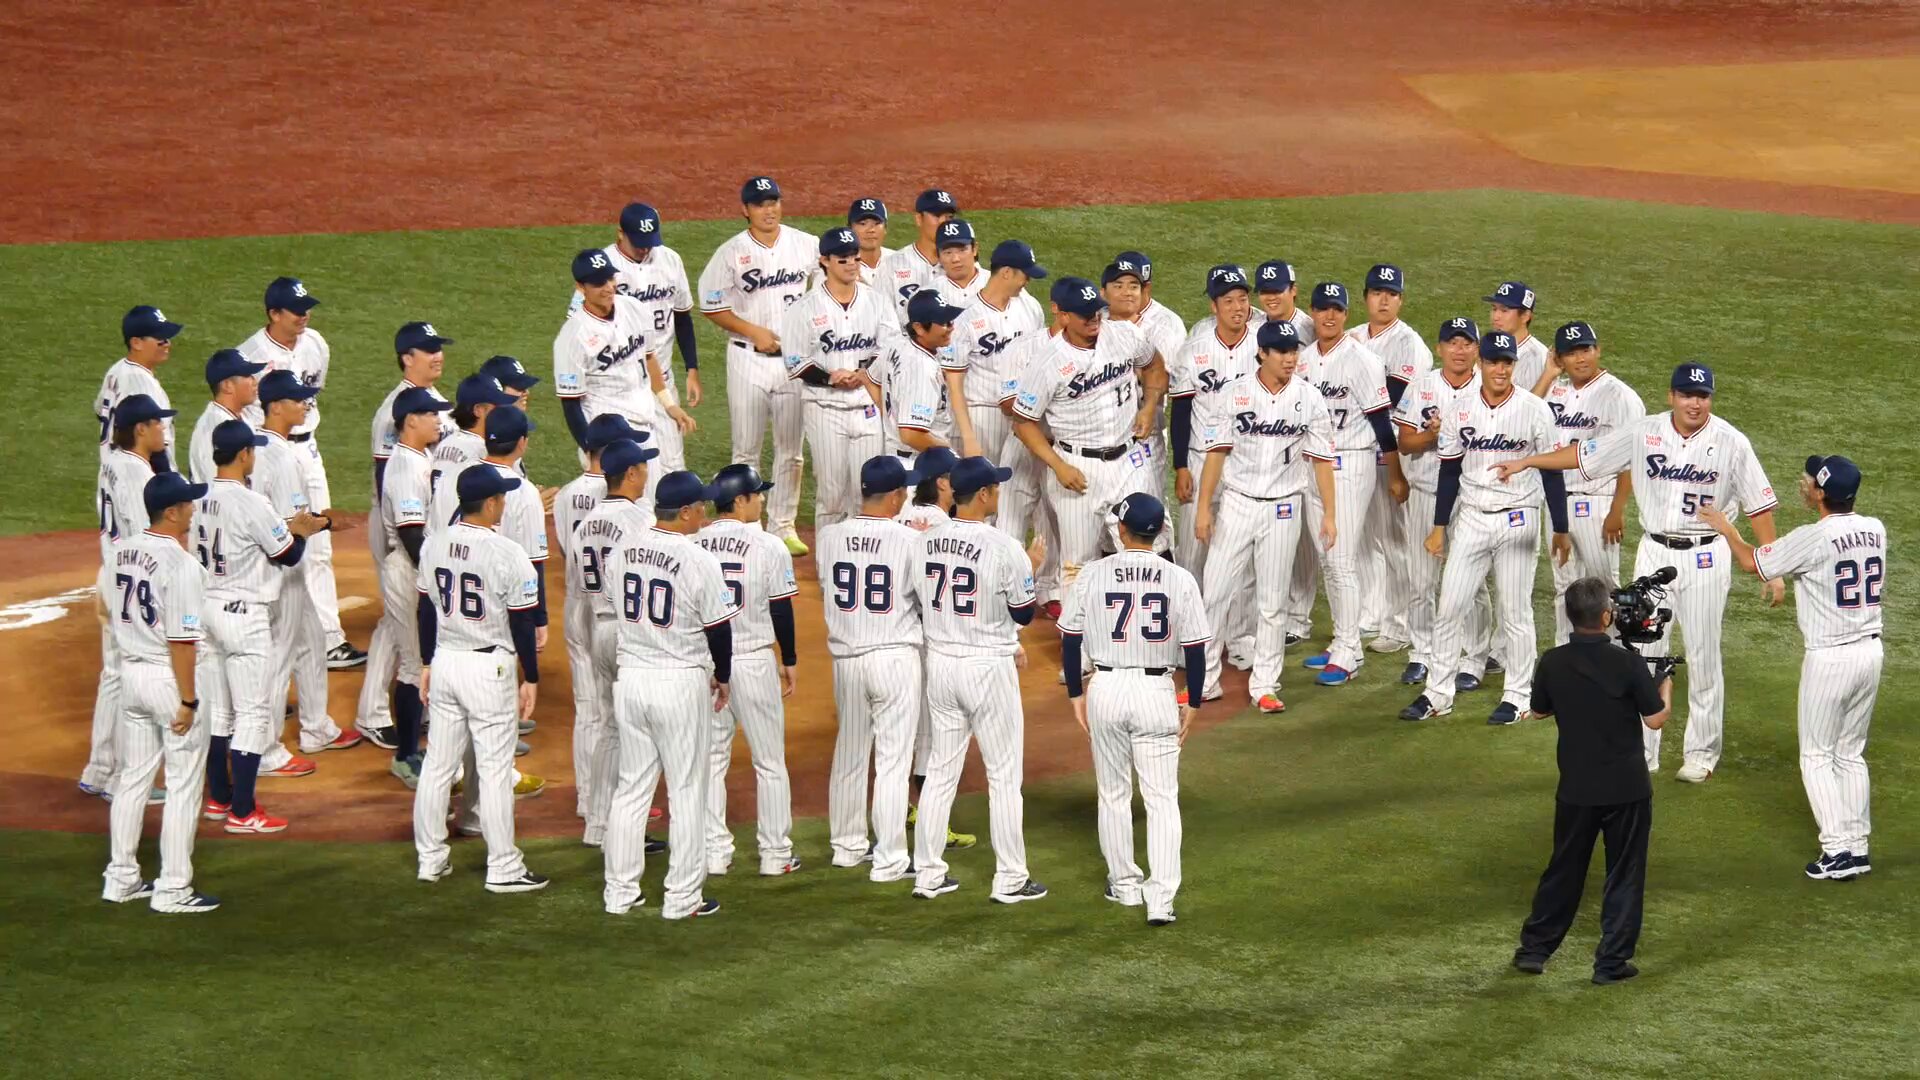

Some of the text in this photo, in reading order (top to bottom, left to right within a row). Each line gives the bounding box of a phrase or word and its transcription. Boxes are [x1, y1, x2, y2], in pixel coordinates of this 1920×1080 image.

[756, 178, 771, 191] YS
[860, 199, 876, 211] YS
[639, 218, 654, 232] YS
[944, 223, 959, 236] YS
[589, 255, 607, 269] YS
[741, 268, 806, 293] Swallows
[1262, 266, 1277, 280] YS
[1378, 267, 1395, 281] YS
[1080, 286, 1097, 301] YS
[1323, 284, 1341, 297] YS
[1279, 323, 1295, 337] YS
[1565, 326, 1582, 341] YS
[597, 332, 645, 371] Swallow
[1494, 335, 1510, 348] YS
[1067, 359, 1132, 399] Swallows
[1689, 368, 1705, 383] YS
[1236, 411, 1308, 437] Swallows
[1460, 427, 1527, 450] Swallows
[1646, 454, 1718, 483] Swallows
[572, 494, 596, 511] KOGA
[847, 537, 882, 552] ISHII
[926, 539, 982, 564] ONODERA
[1832, 531, 1880, 554] TAKATSU
[624, 548, 681, 577] YOSHIOKA
[1114, 567, 1162, 584] SHIMA
[1835, 556, 1882, 609] 22
[434, 567, 486, 621] 86
[833, 562, 893, 614] 98
[925, 562, 977, 616] 72
[116, 573, 159, 628] 78
[623, 572, 675, 629] 80
[1105, 592, 1171, 642] 73
